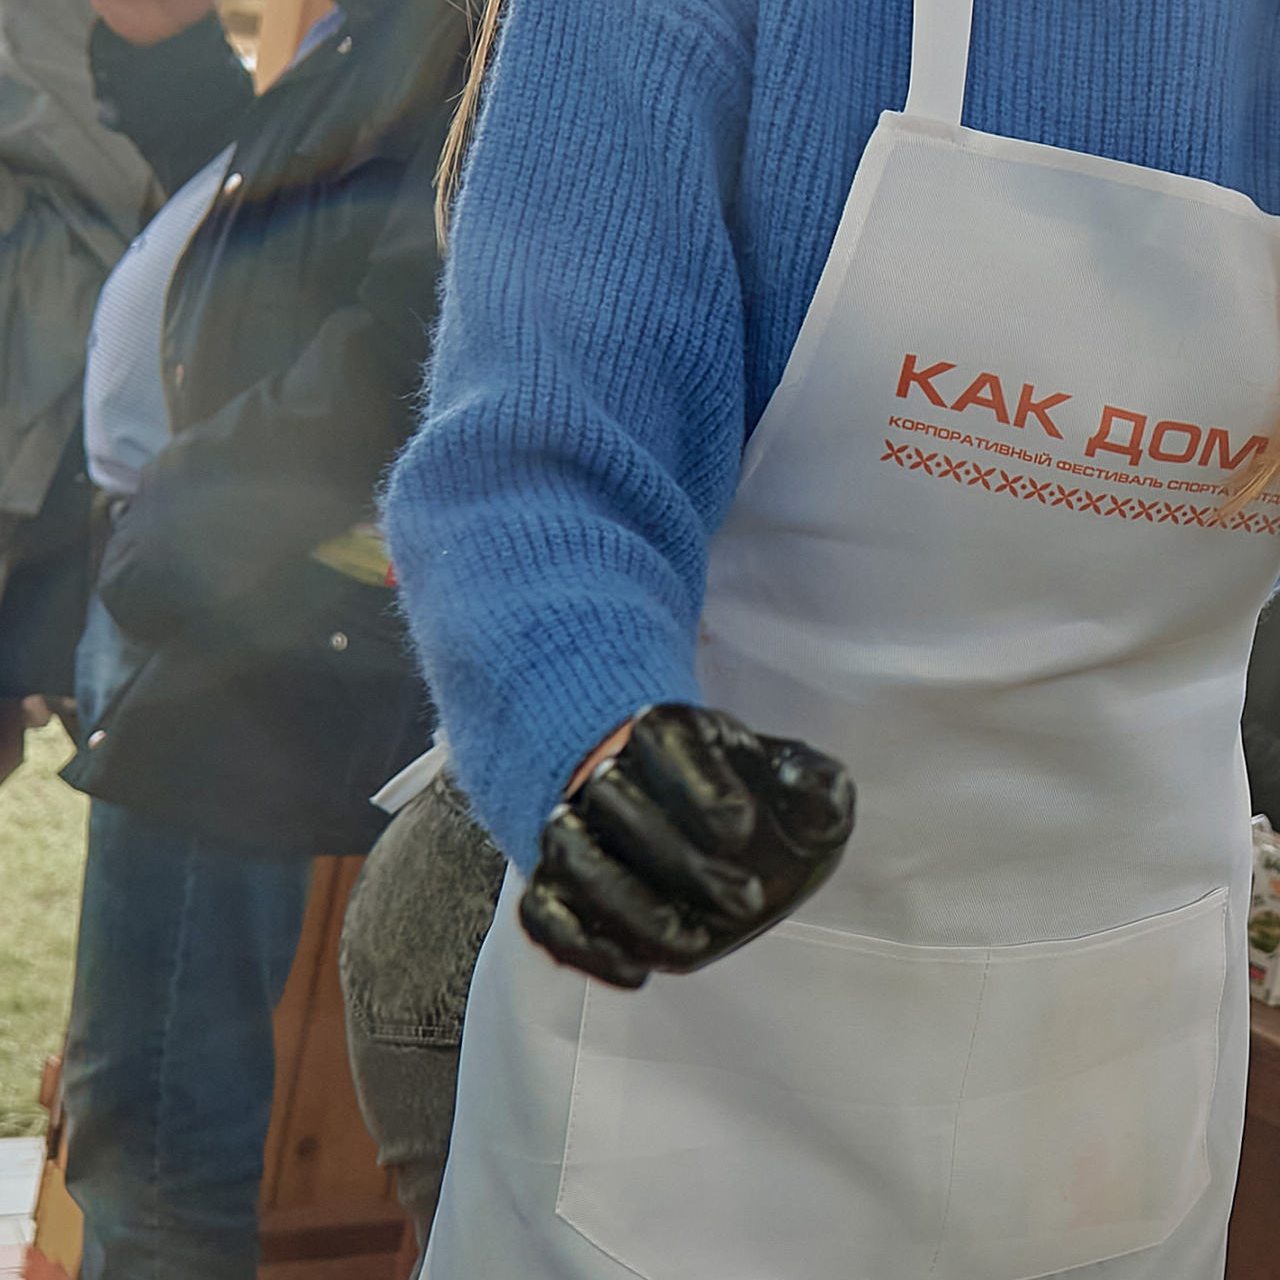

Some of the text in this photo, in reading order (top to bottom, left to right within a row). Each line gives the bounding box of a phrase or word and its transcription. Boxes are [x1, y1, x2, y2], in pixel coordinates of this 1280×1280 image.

[895, 353, 1073, 440] КАК
[888, 416, 1053, 468] КОРПОРАТИВНЫЙ
[1056, 460, 1163, 489] ФЕСТИВАЛЬ
[1166, 478, 1230, 498] СПОРТА
